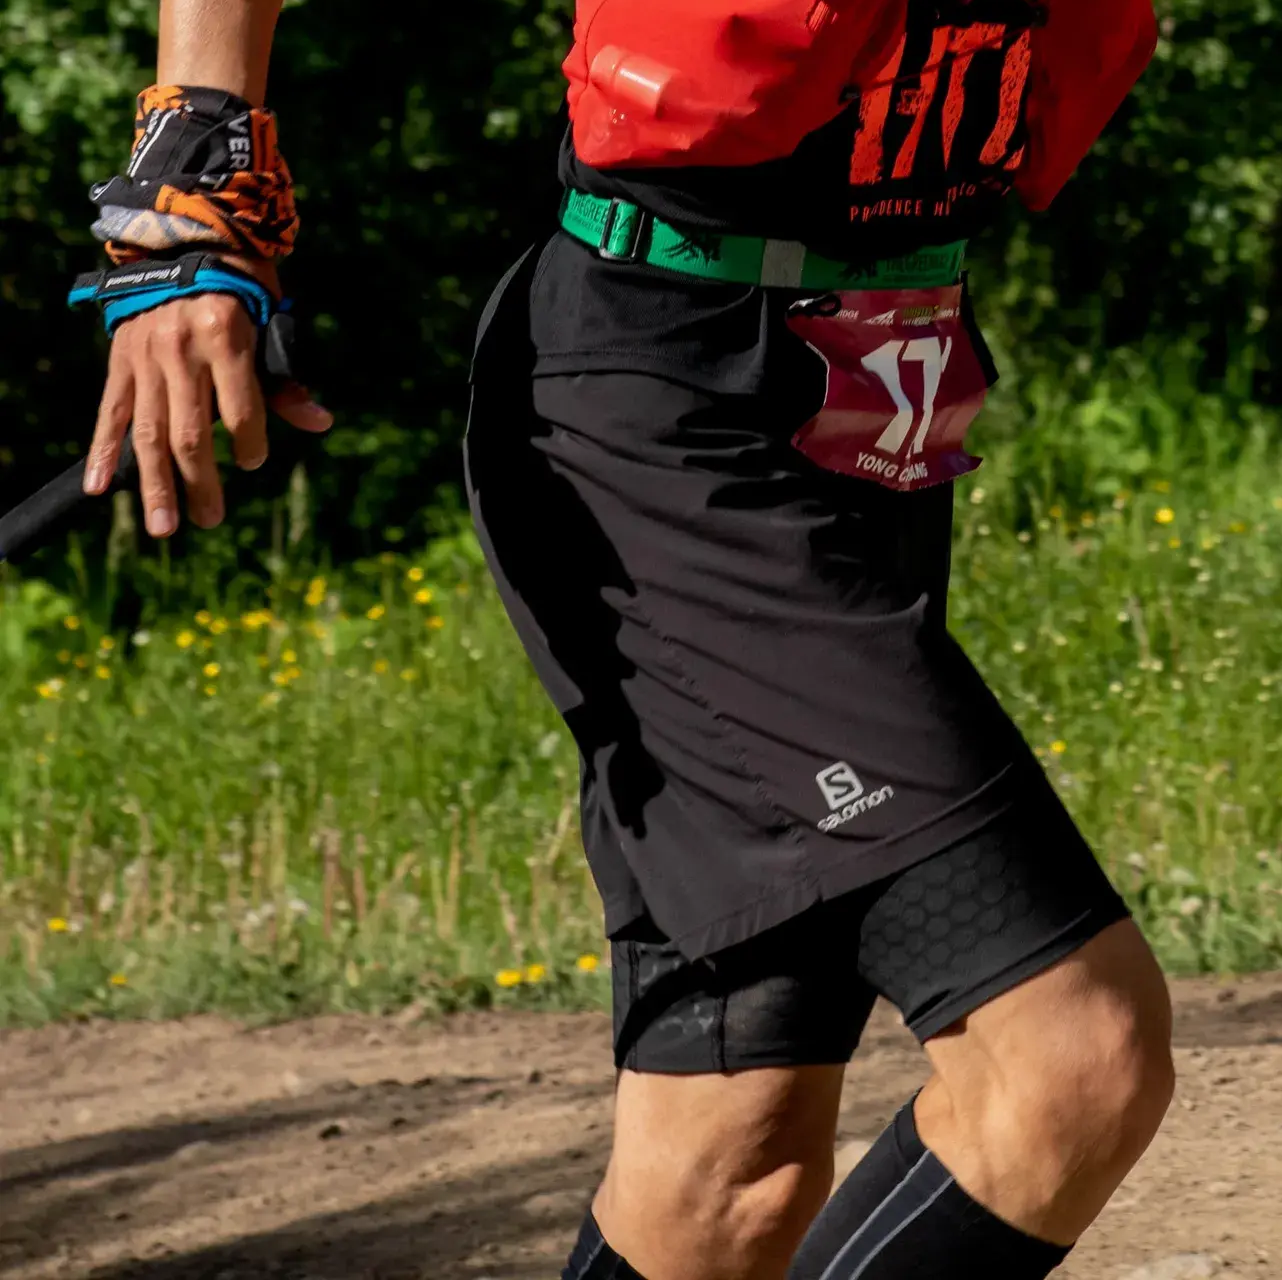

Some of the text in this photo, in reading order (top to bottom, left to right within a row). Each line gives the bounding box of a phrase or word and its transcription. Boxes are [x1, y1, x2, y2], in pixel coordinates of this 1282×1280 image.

[861, 336, 952, 458] 17
[855, 451, 899, 479] YONG
[817, 785, 894, 833] salomon
